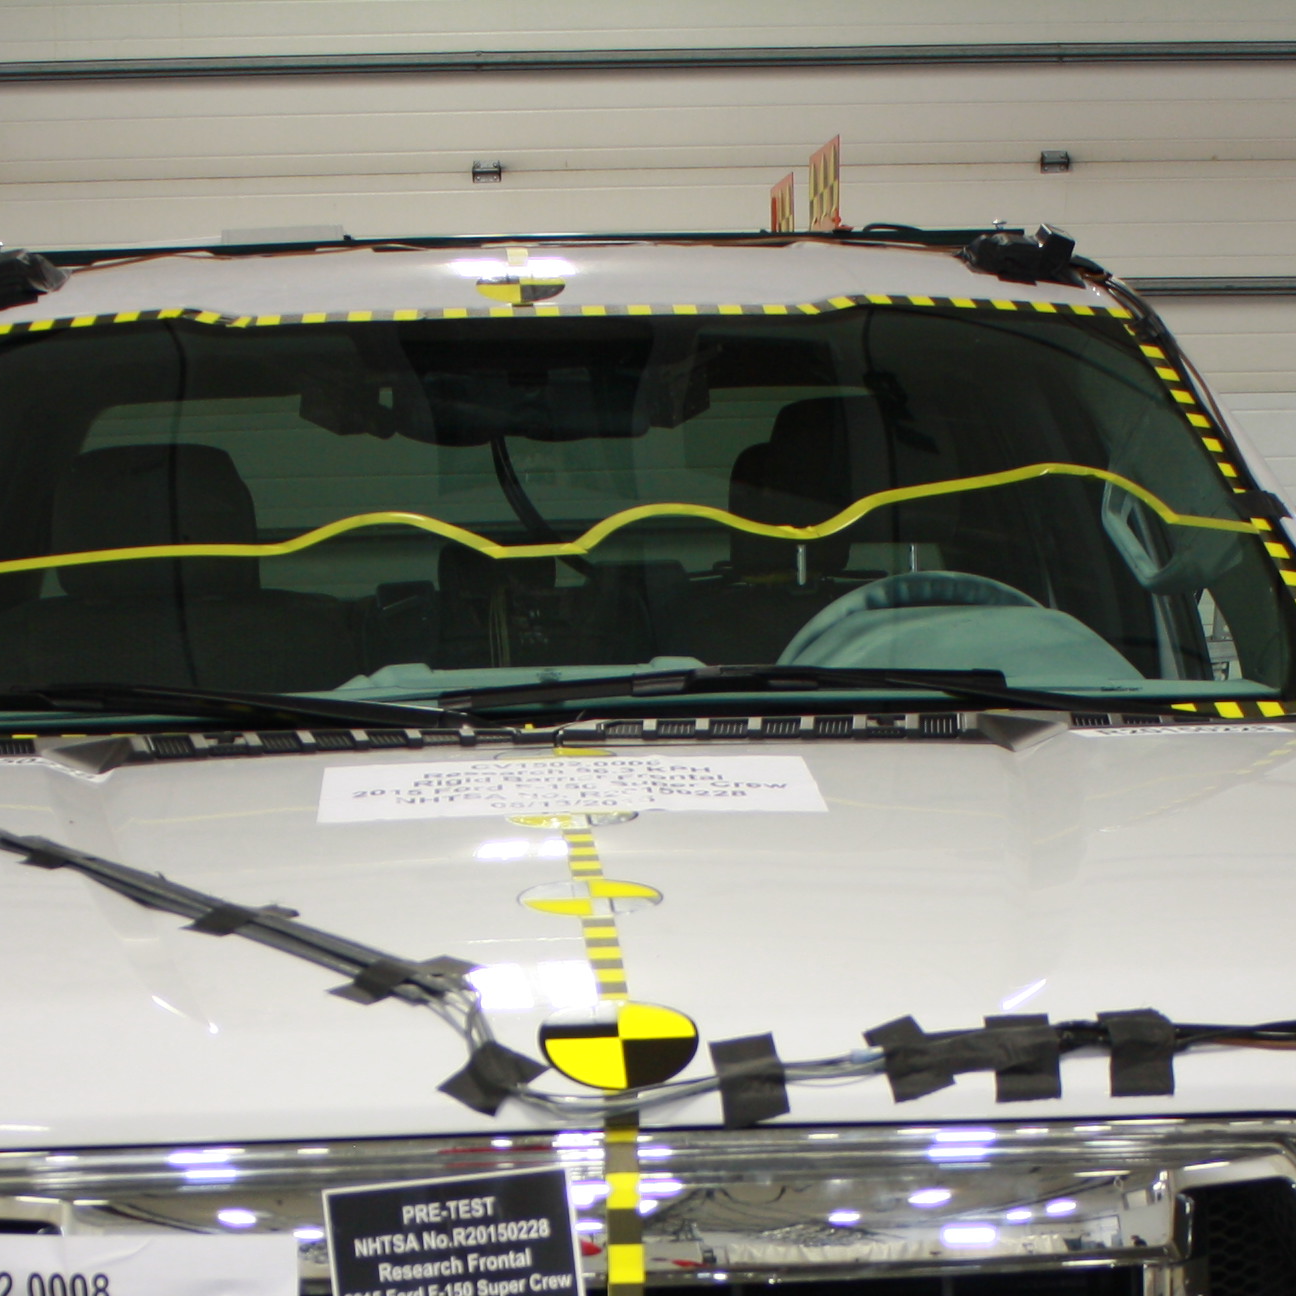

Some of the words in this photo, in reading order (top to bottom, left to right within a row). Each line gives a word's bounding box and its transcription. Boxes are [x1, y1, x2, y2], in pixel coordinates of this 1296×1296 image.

[402, 1196, 495, 1225] PRE-TEST
[354, 1233, 420, 1257] NHTSA
[378, 1256, 464, 1283] Research
[467, 1248, 532, 1272] Frontal
[529, 1273, 572, 1292] Crew
